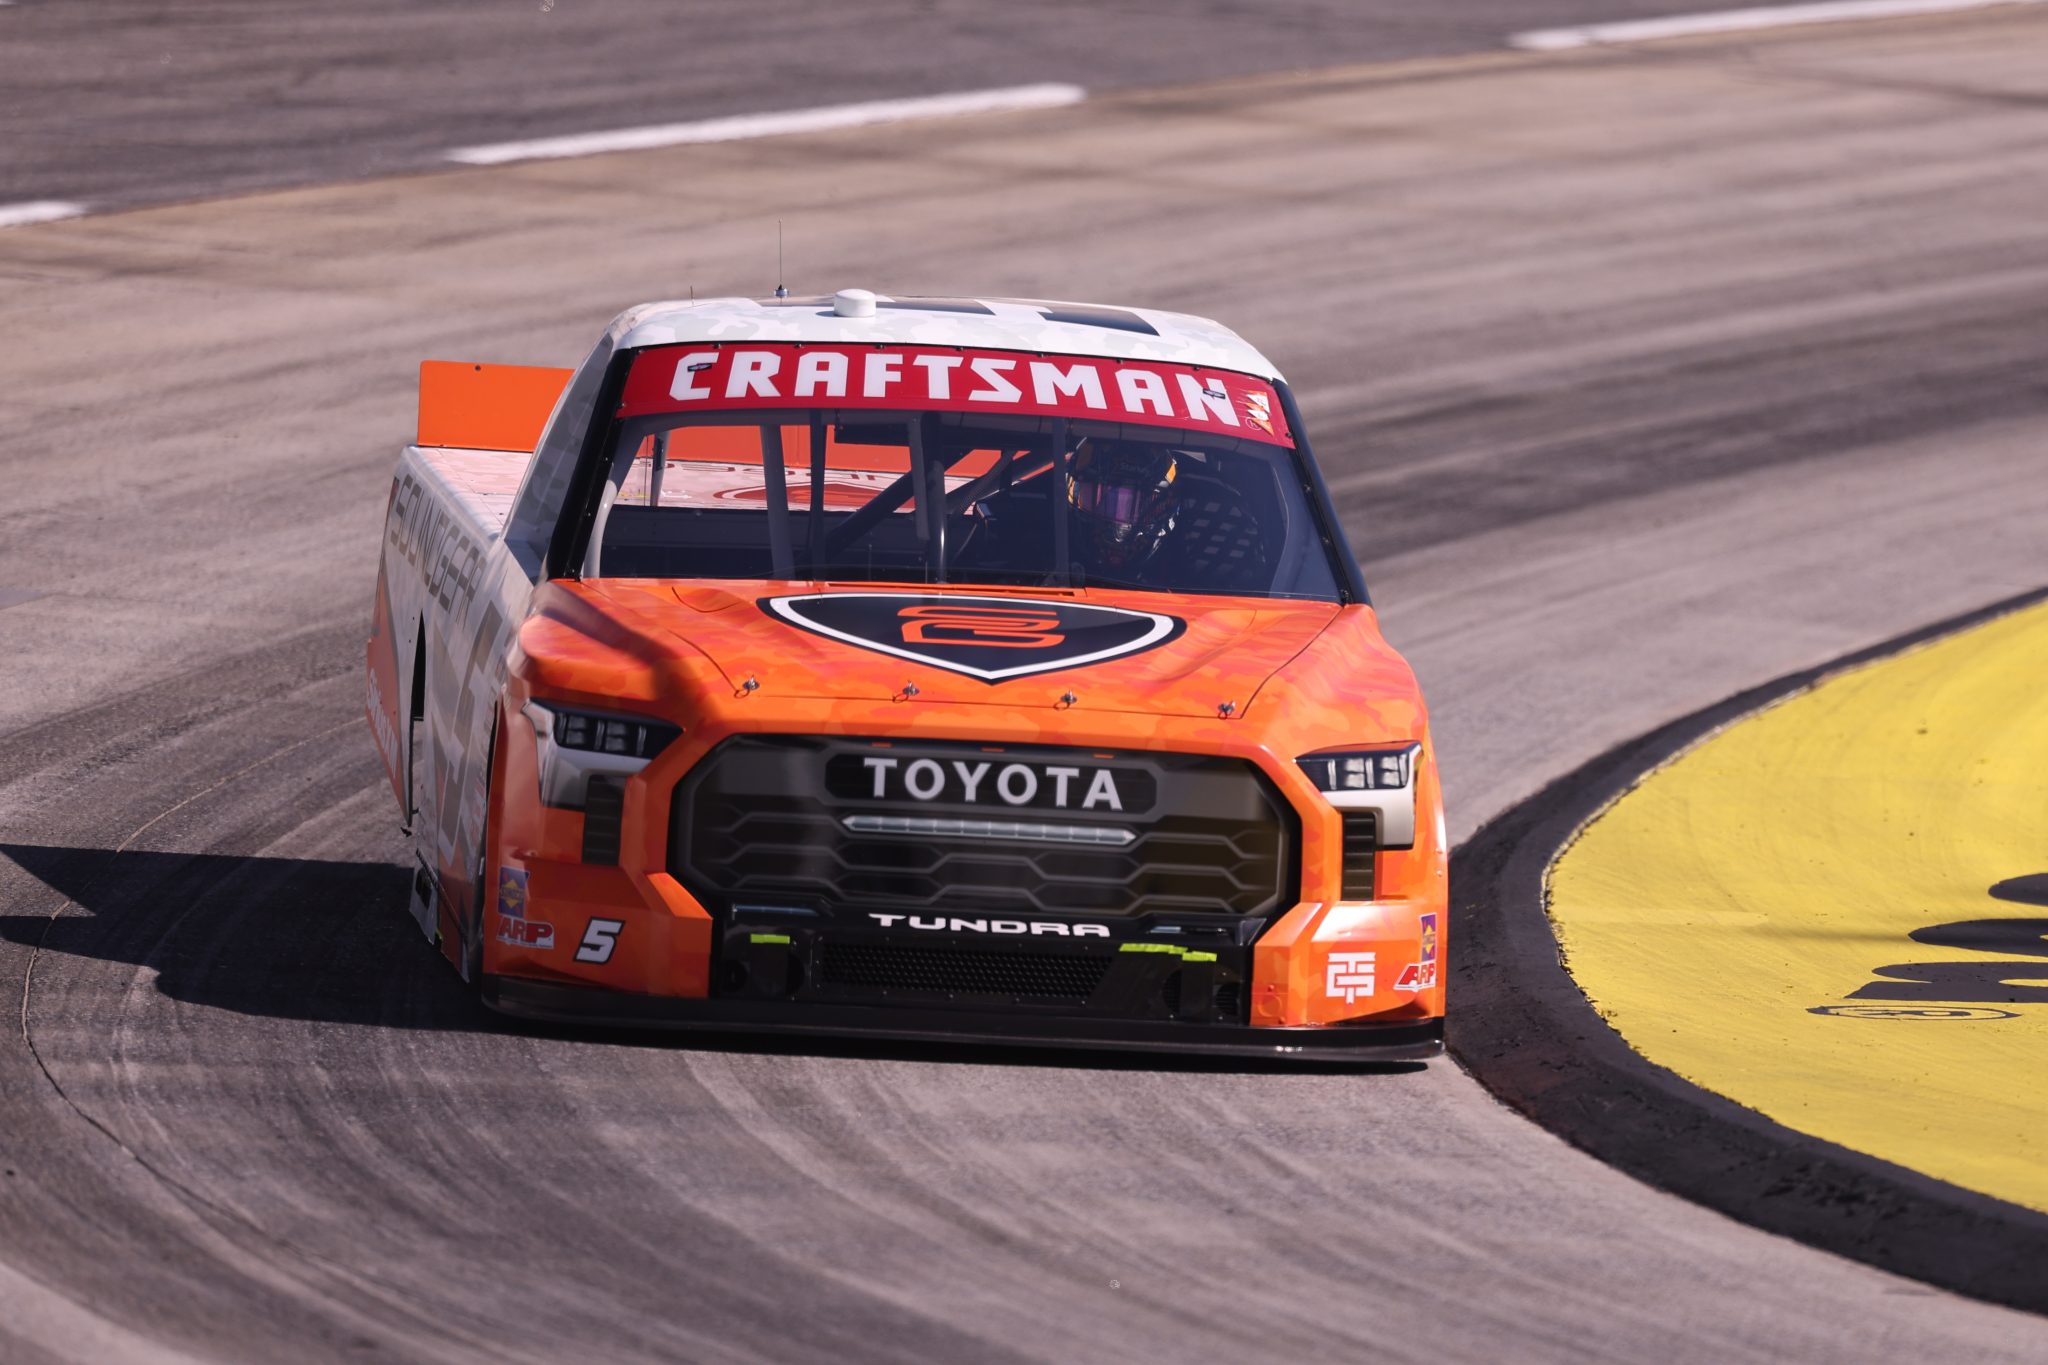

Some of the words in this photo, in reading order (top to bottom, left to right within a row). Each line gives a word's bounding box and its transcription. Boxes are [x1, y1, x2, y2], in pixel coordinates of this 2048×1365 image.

[669, 351, 1241, 427] CRAFTSMAN
[863, 756, 1124, 811] TOYOTA
[498, 917, 553, 944] ARP
[574, 916, 625, 964] 5
[868, 912, 1111, 938] TUNDRA
[1397, 963, 1436, 986] ARP
